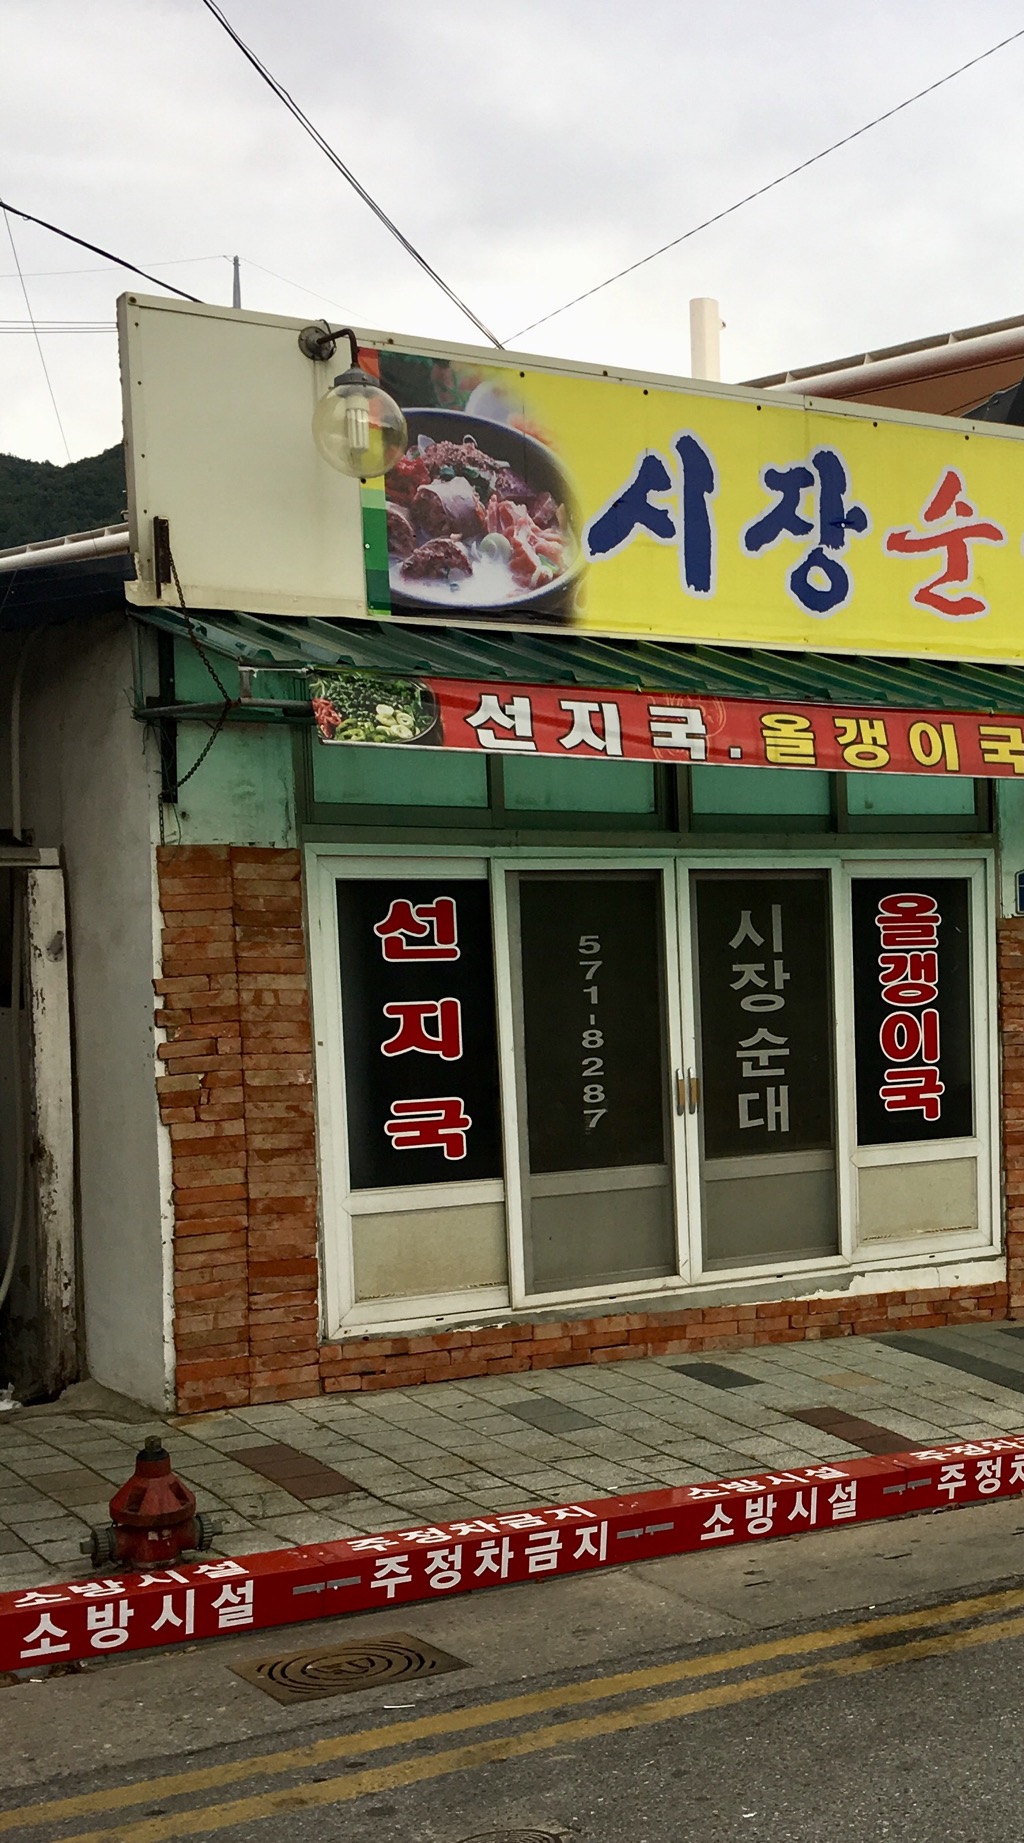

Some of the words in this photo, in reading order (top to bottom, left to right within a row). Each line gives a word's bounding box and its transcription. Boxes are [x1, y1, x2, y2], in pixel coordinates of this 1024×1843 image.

[373, 896, 472, 1161] 선지국
[578, 935, 608, 1128] 571-8287
[728, 904, 791, 1133] 시장순대
[875, 893, 945, 1121] 올갱이국
[686, 1465, 851, 1499] 소방시설
[700, 1480, 858, 1541] 소방시설
[346, 1504, 598, 1553] 주정차금지
[370, 1520, 608, 1598] 주정차금지
[14, 1559, 250, 1608] 소방시설
[19, 1580, 255, 1659] 소방시설
